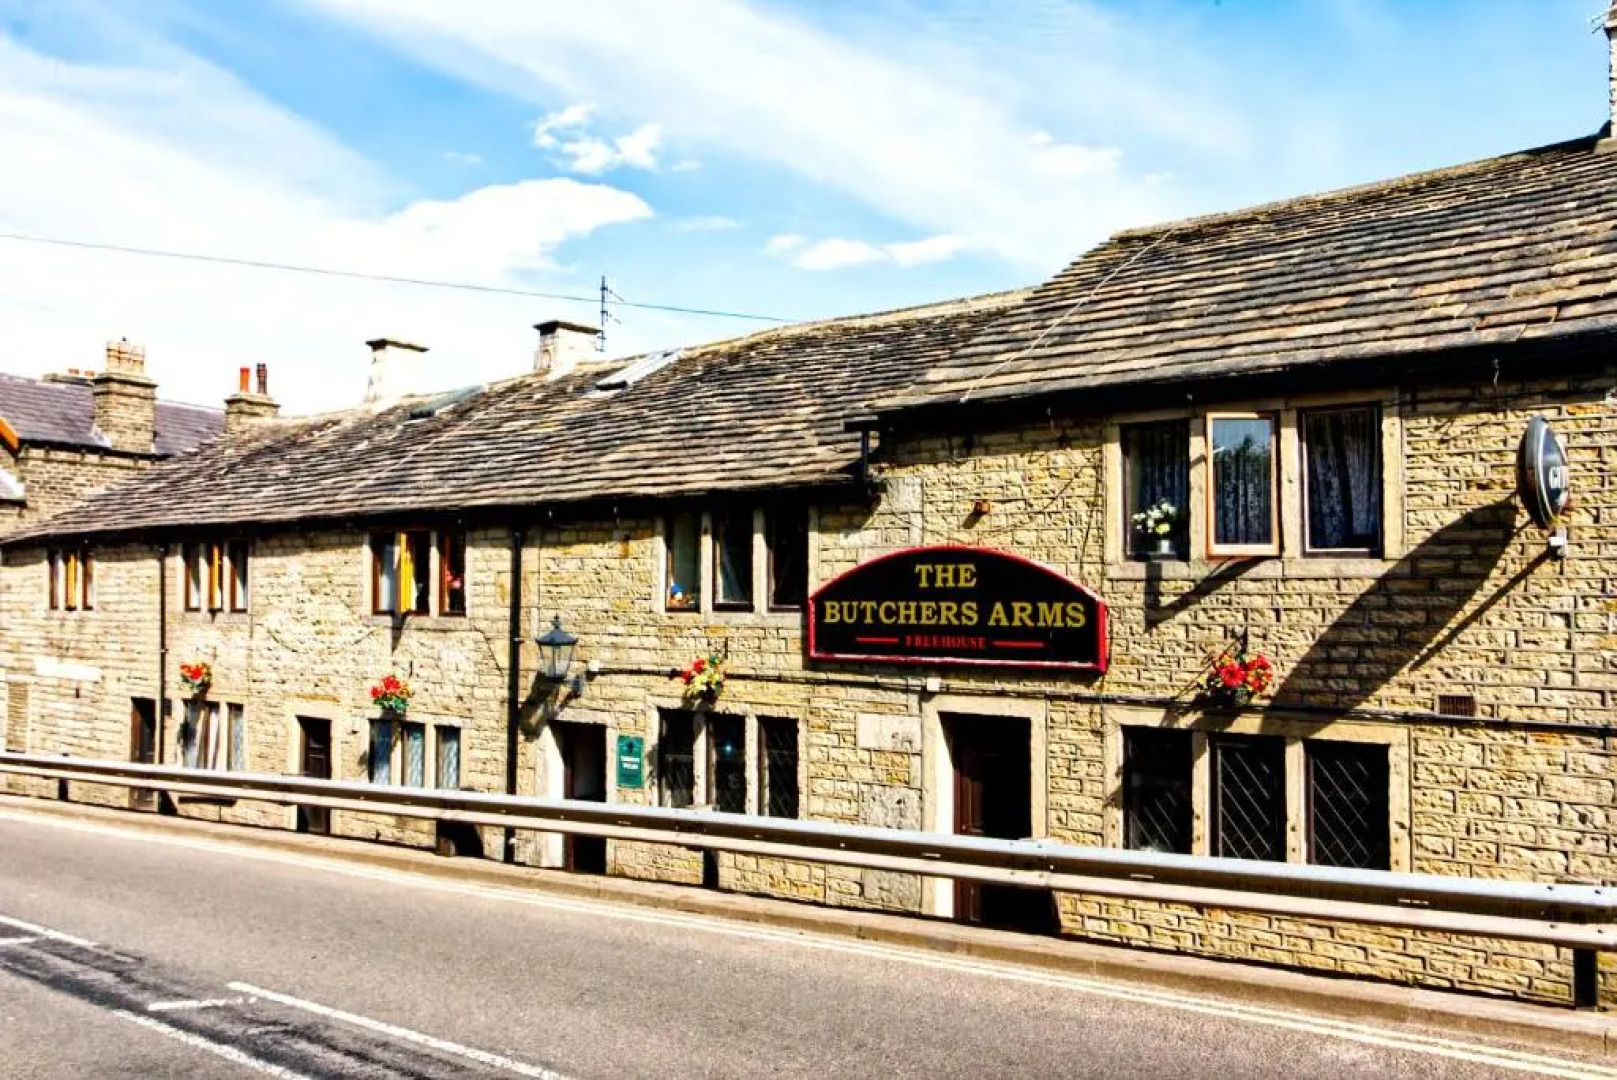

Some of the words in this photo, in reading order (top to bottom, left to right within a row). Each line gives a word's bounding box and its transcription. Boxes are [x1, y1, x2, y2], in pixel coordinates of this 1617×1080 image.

[915, 564, 976, 587] THE
[824, 601, 978, 625] BUTCHERS
[988, 602, 1086, 627] ARMS
[905, 635, 986, 649] FREEHOUSE
